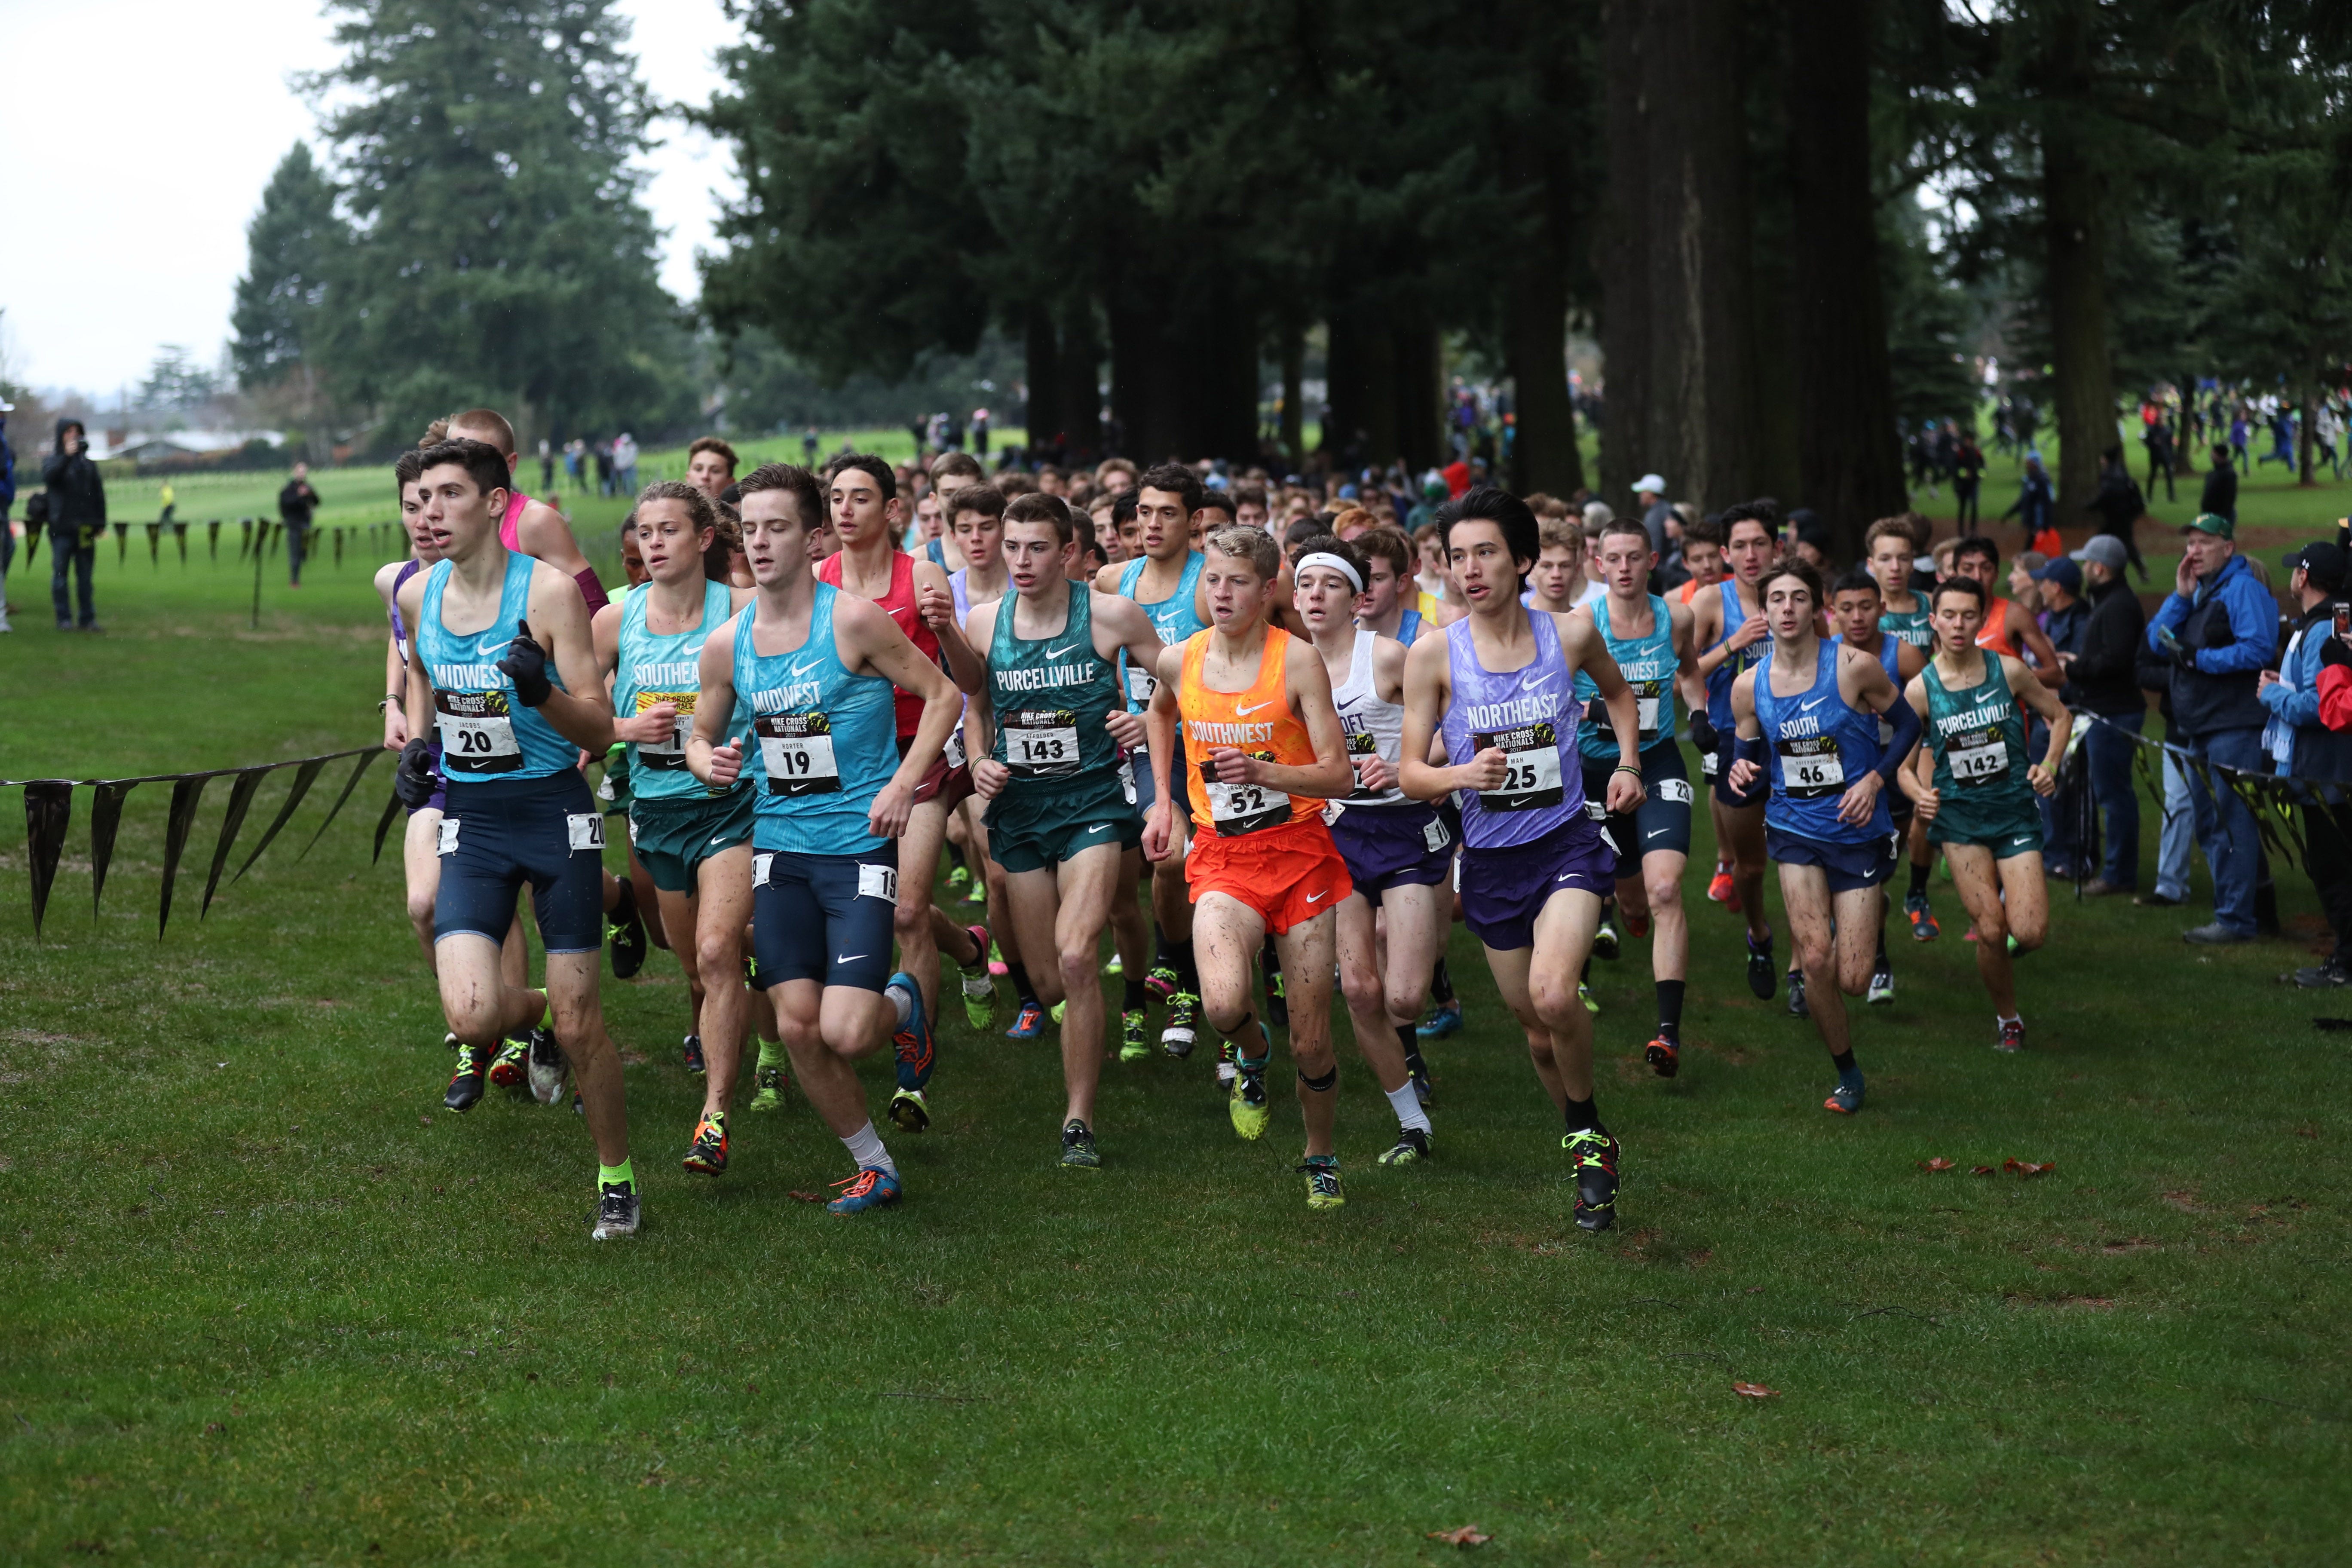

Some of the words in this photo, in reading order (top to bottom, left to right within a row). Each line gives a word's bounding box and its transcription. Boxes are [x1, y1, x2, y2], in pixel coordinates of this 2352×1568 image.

[1746, 641, 1775, 659] SOUT
[634, 662, 700, 686] SOUTHEA
[995, 663, 1095, 691] PURCELLVILLE
[1618, 661, 1659, 680] DWEST
[447, 695, 460, 704] NIKE
[462, 696, 485, 704] CROSS
[450, 702, 485, 713] NATIONALS
[751, 681, 821, 713] MIDWEST
[771, 717, 784, 726] NIKE
[786, 717, 807, 725] CROSS
[1467, 693, 1558, 729] NORTHEAST
[1936, 702, 2011, 736] PURCELLVILLE
[774, 724, 807, 733] NATIONALS
[1188, 720, 1274, 744] SOUTHWEST
[1493, 734, 1510, 743] NIKE
[1511, 729, 1534, 740] CROSS
[1779, 716, 1820, 739] SOUTH
[458, 730, 492, 753] 20
[1022, 740, 1064, 760] 143
[1496, 736, 1534, 750] NATIONALS
[783, 751, 810, 775] 19
[1800, 766, 1824, 783] 46
[1964, 755, 1998, 774] 142
[1504, 765, 1537, 790] 25
[1231, 789, 1265, 814] 52
[1675, 781, 1690, 800] 23
[588, 817, 605, 845] 20
[882, 870, 897, 899] 19
